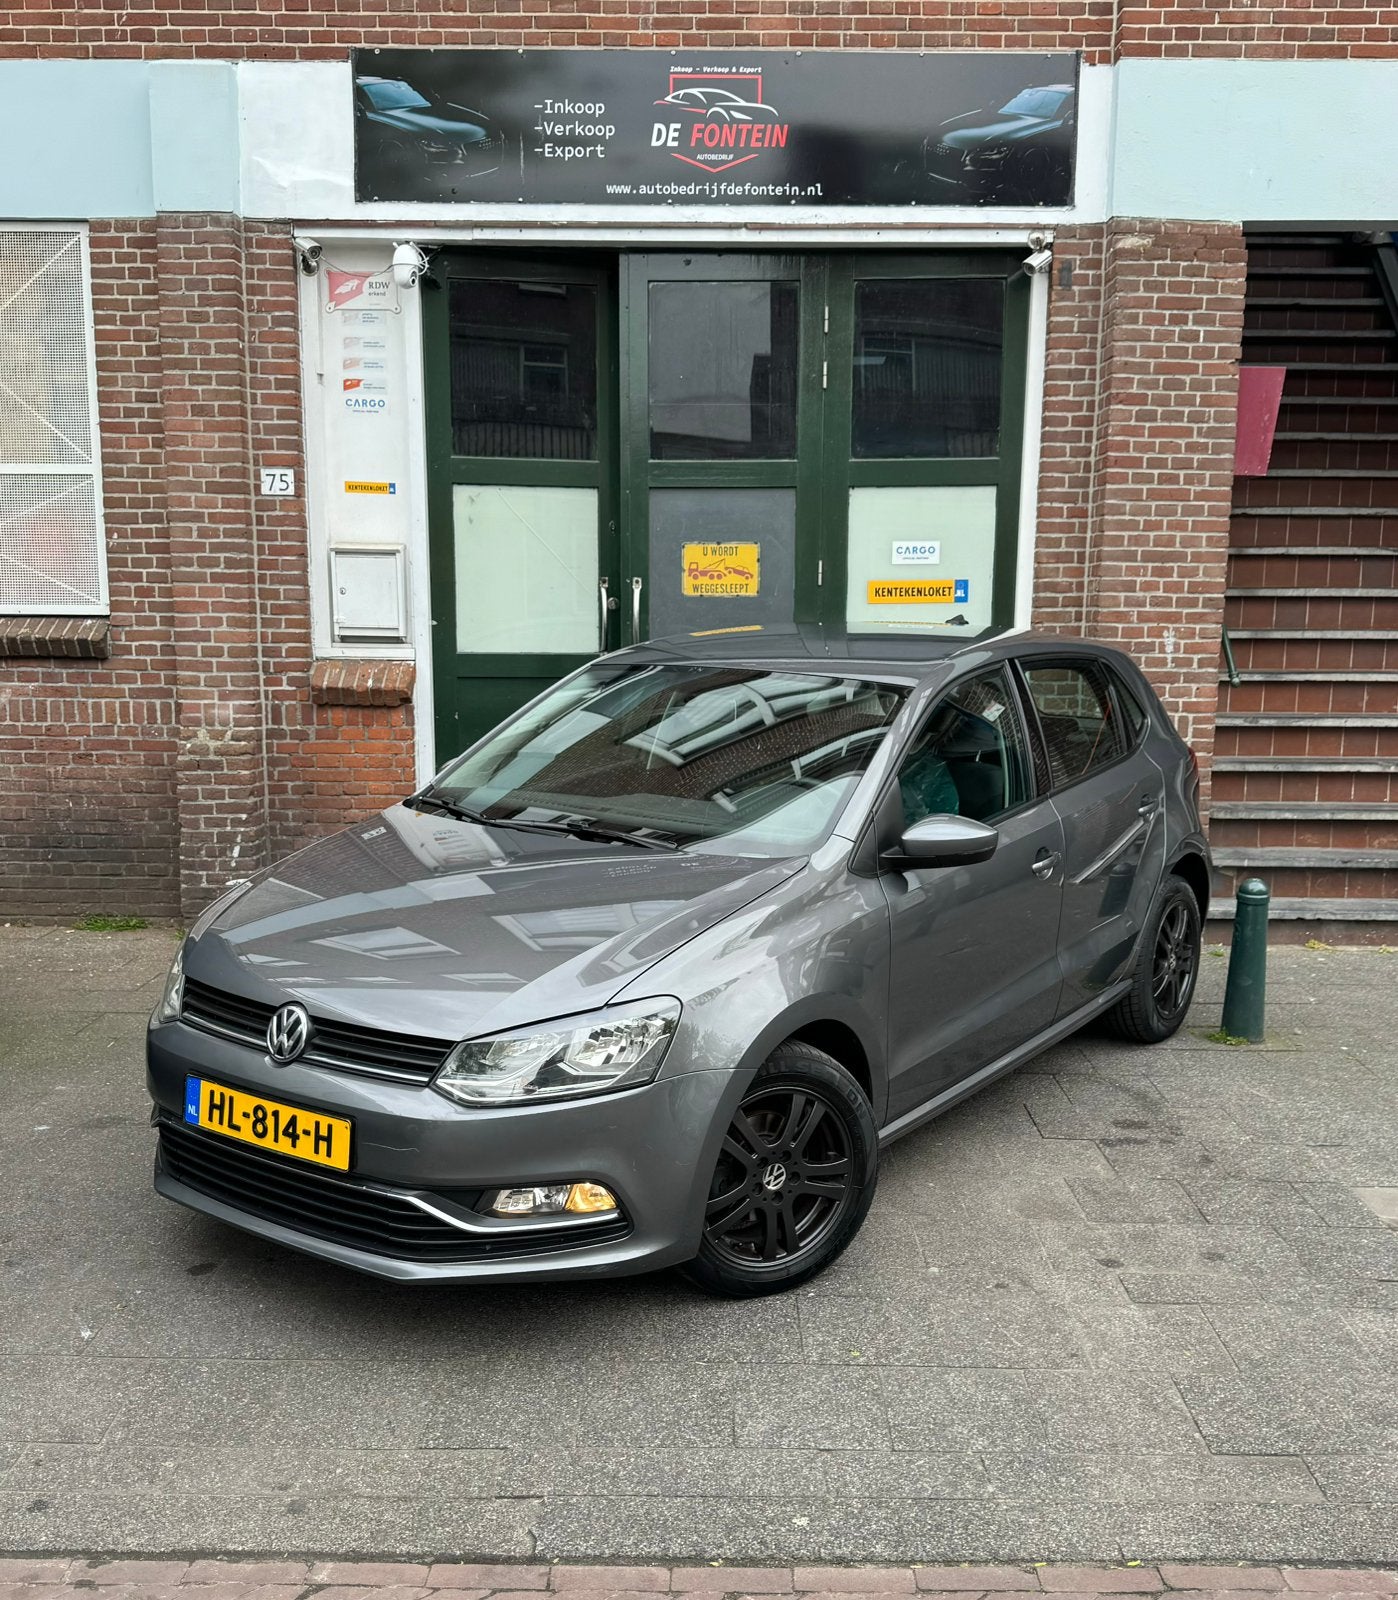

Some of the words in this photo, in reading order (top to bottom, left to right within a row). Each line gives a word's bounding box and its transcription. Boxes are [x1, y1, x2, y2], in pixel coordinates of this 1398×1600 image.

[650, 123, 682, 147] DE
[690, 123, 789, 148] FONTEIN
[696, 153, 734, 161] AUTOBEDRIJF
[606, 182, 823, 198] www.autobedrijfdefontein.nl
[368, 281, 391, 290] RDW
[345, 398, 386, 408] CARGO
[265, 473, 290, 492] 75
[702, 546, 708, 556] U
[711, 546, 739, 556] WORDT
[896, 546, 936, 555] CARGO
[692, 583, 749, 594] WEGGESLEEPT
[874, 587, 953, 597] KENTEKENLOKET
[187, 1104, 198, 1117] NL
[208, 1089, 333, 1158] HL-814-H
